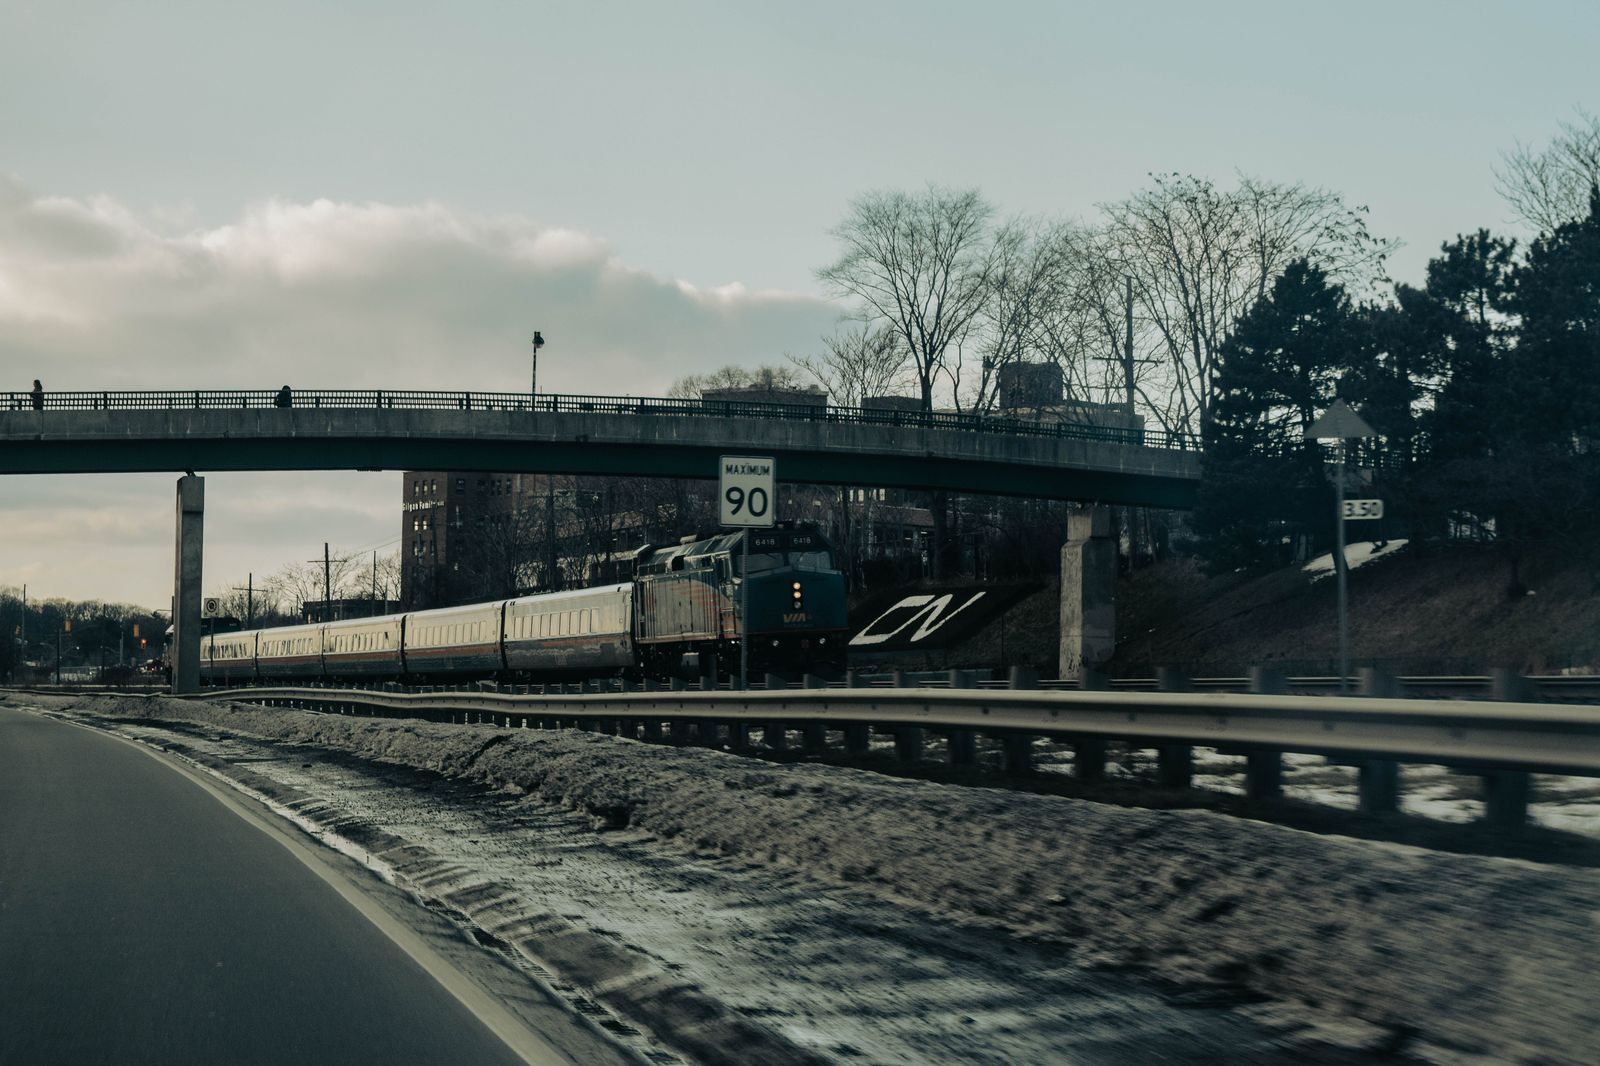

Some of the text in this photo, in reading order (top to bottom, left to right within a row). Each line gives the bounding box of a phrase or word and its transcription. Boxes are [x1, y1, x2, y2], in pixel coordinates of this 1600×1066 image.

[725, 464, 770, 476] MAXIMUM
[726, 486, 768, 517] 90
[782, 612, 806, 623] VIA
[848, 591, 987, 646] CN
